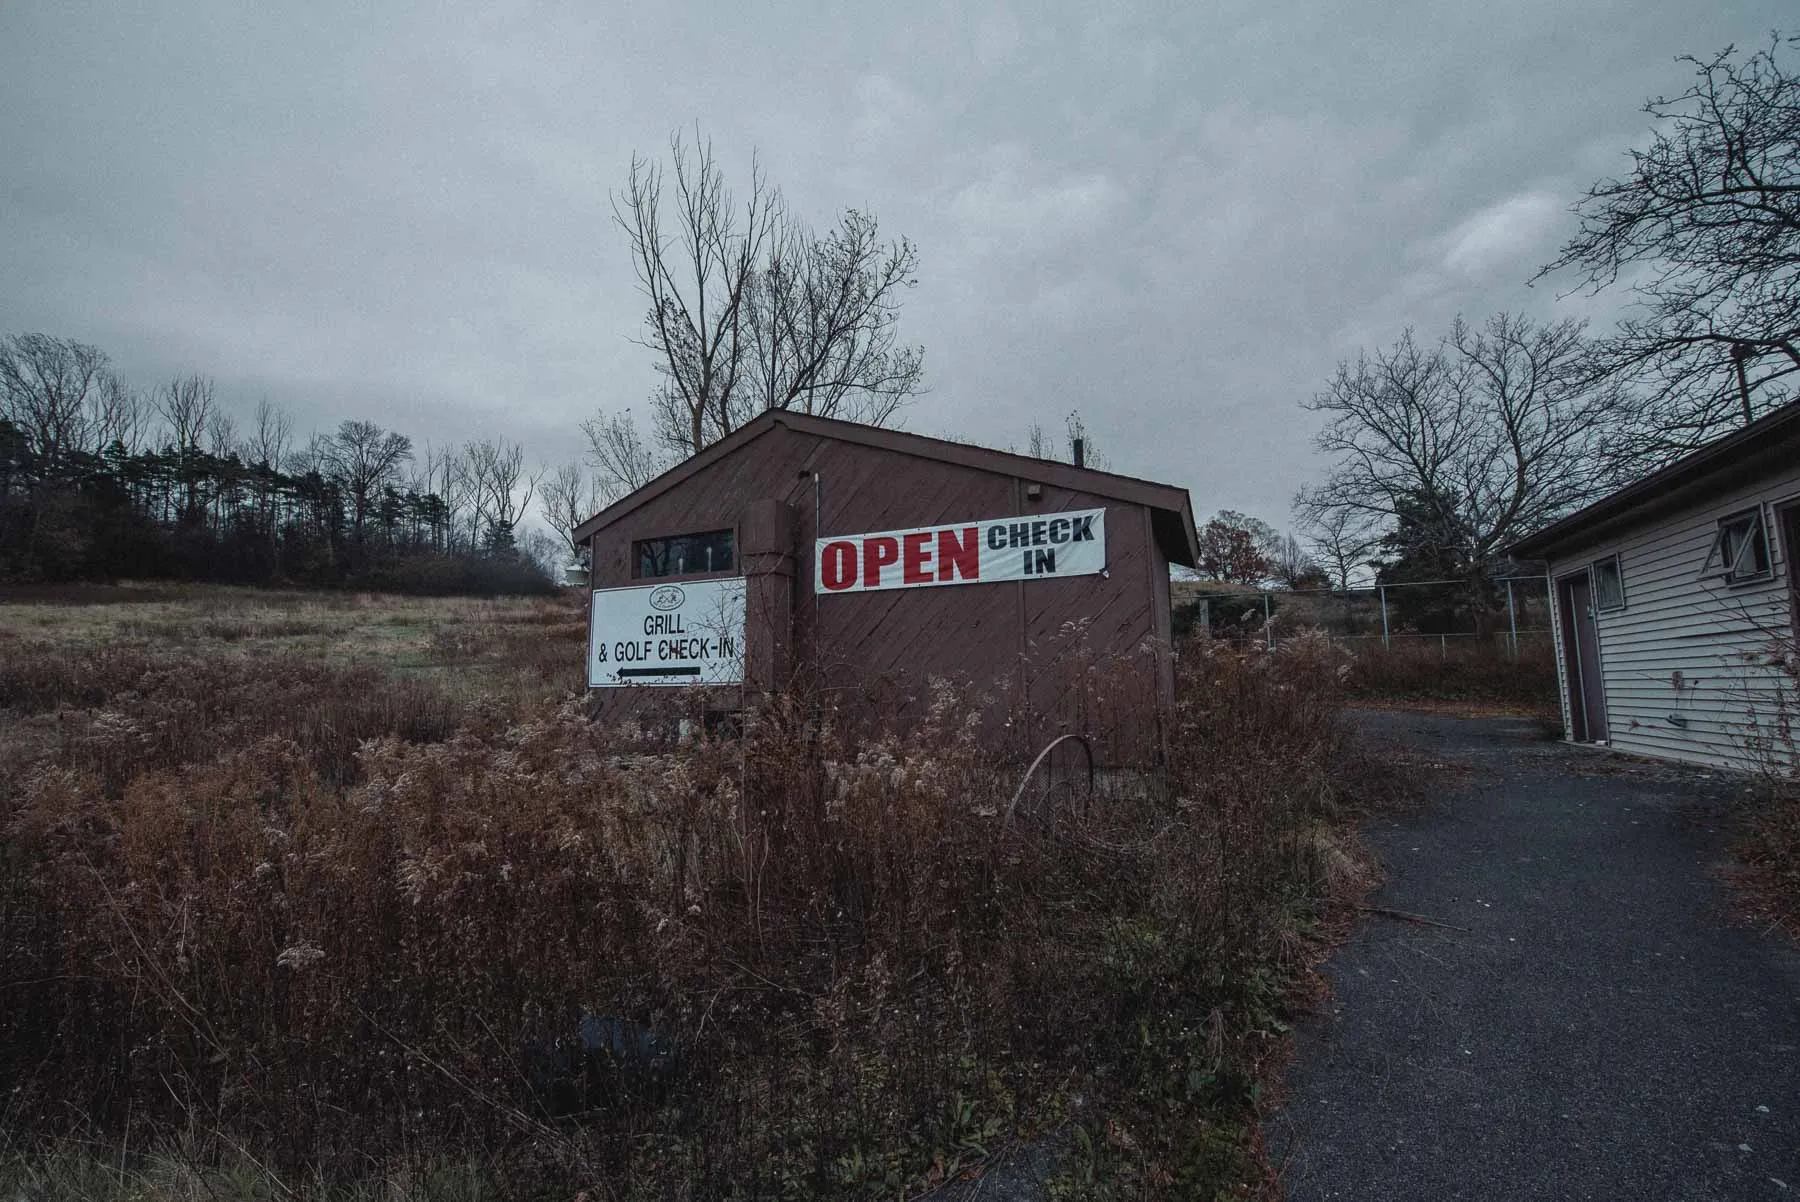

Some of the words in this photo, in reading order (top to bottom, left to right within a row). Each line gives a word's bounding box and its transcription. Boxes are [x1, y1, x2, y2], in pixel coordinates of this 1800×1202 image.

[987, 516, 1094, 550] CHECK
[821, 527, 979, 590] OPEN
[1023, 548, 1056, 575] IN
[644, 614, 685, 635] GRILL
[599, 643, 607, 662] &
[615, 641, 652, 661] GOLF
[658, 637, 734, 660] CHECK-IN
